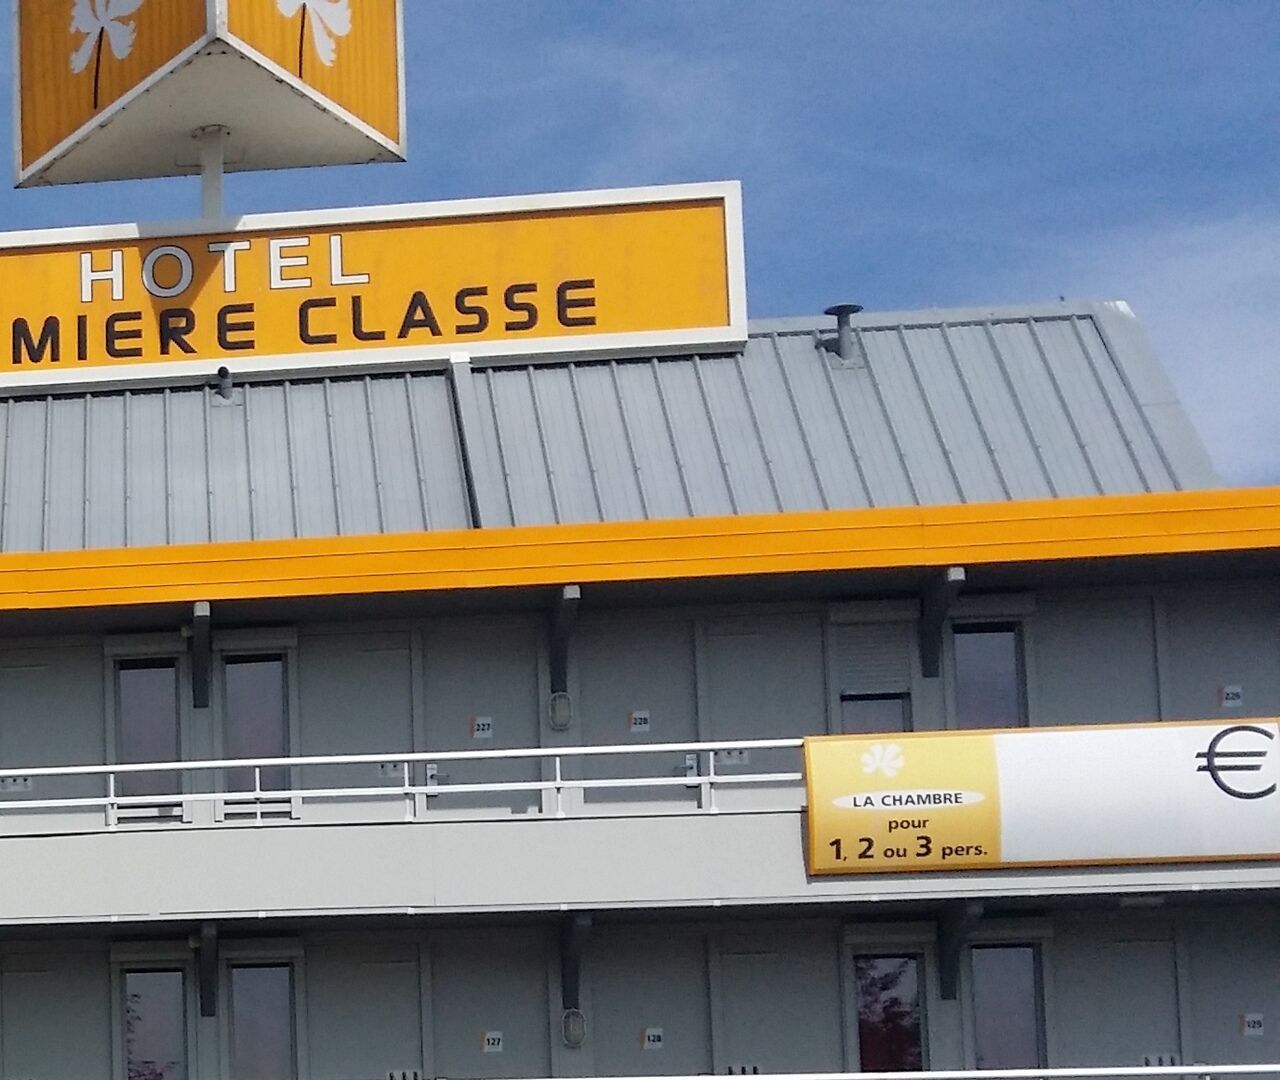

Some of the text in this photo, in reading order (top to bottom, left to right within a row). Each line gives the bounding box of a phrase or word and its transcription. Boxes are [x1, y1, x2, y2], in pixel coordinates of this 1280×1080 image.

[79, 232, 370, 302] HOTEL
[298, 277, 597, 345] CLASSE
[1194, 725, 1278, 800] €
[852, 792, 963, 808] LA CHAMBRE
[888, 818, 930, 834] pour
[829, 835, 988, 862] 1, 2 ou 3 pers.
[486, 1037, 501, 1046] 127
